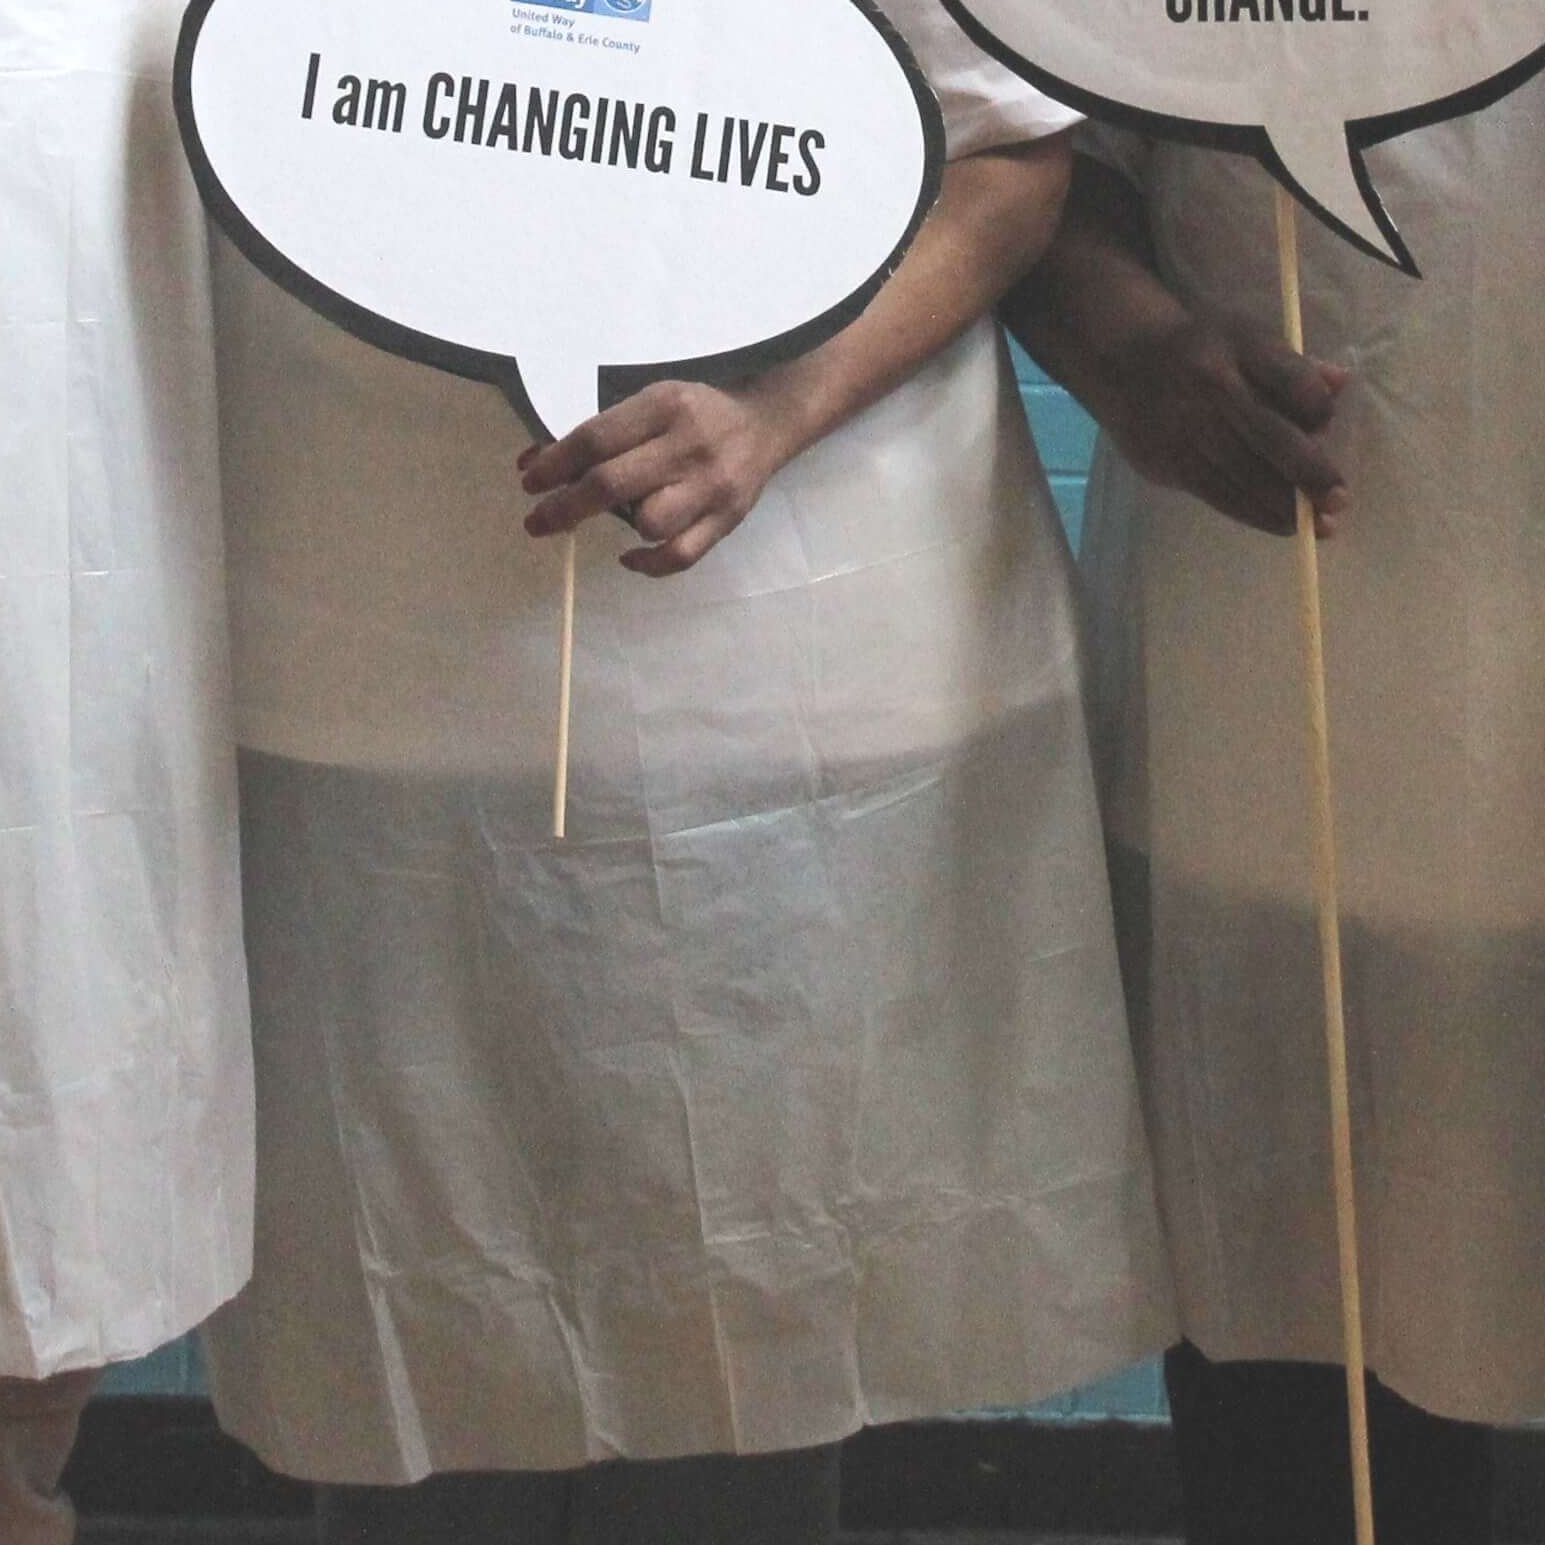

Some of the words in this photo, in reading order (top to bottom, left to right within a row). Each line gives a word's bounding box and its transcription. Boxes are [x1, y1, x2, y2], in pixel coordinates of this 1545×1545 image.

[512, 8, 548, 23] United
[552, 13, 575, 28] Way
[510, 24, 521, 34] of
[524, 25, 563, 41] Buffalo
[566, 33, 574, 42] &
[578, 34, 599, 47] Erie
[602, 37, 640, 54] County
[301, 53, 320, 119] I
[332, 73, 407, 132] am
[422, 72, 676, 174] CHANGING
[690, 112, 826, 197] LIVES
